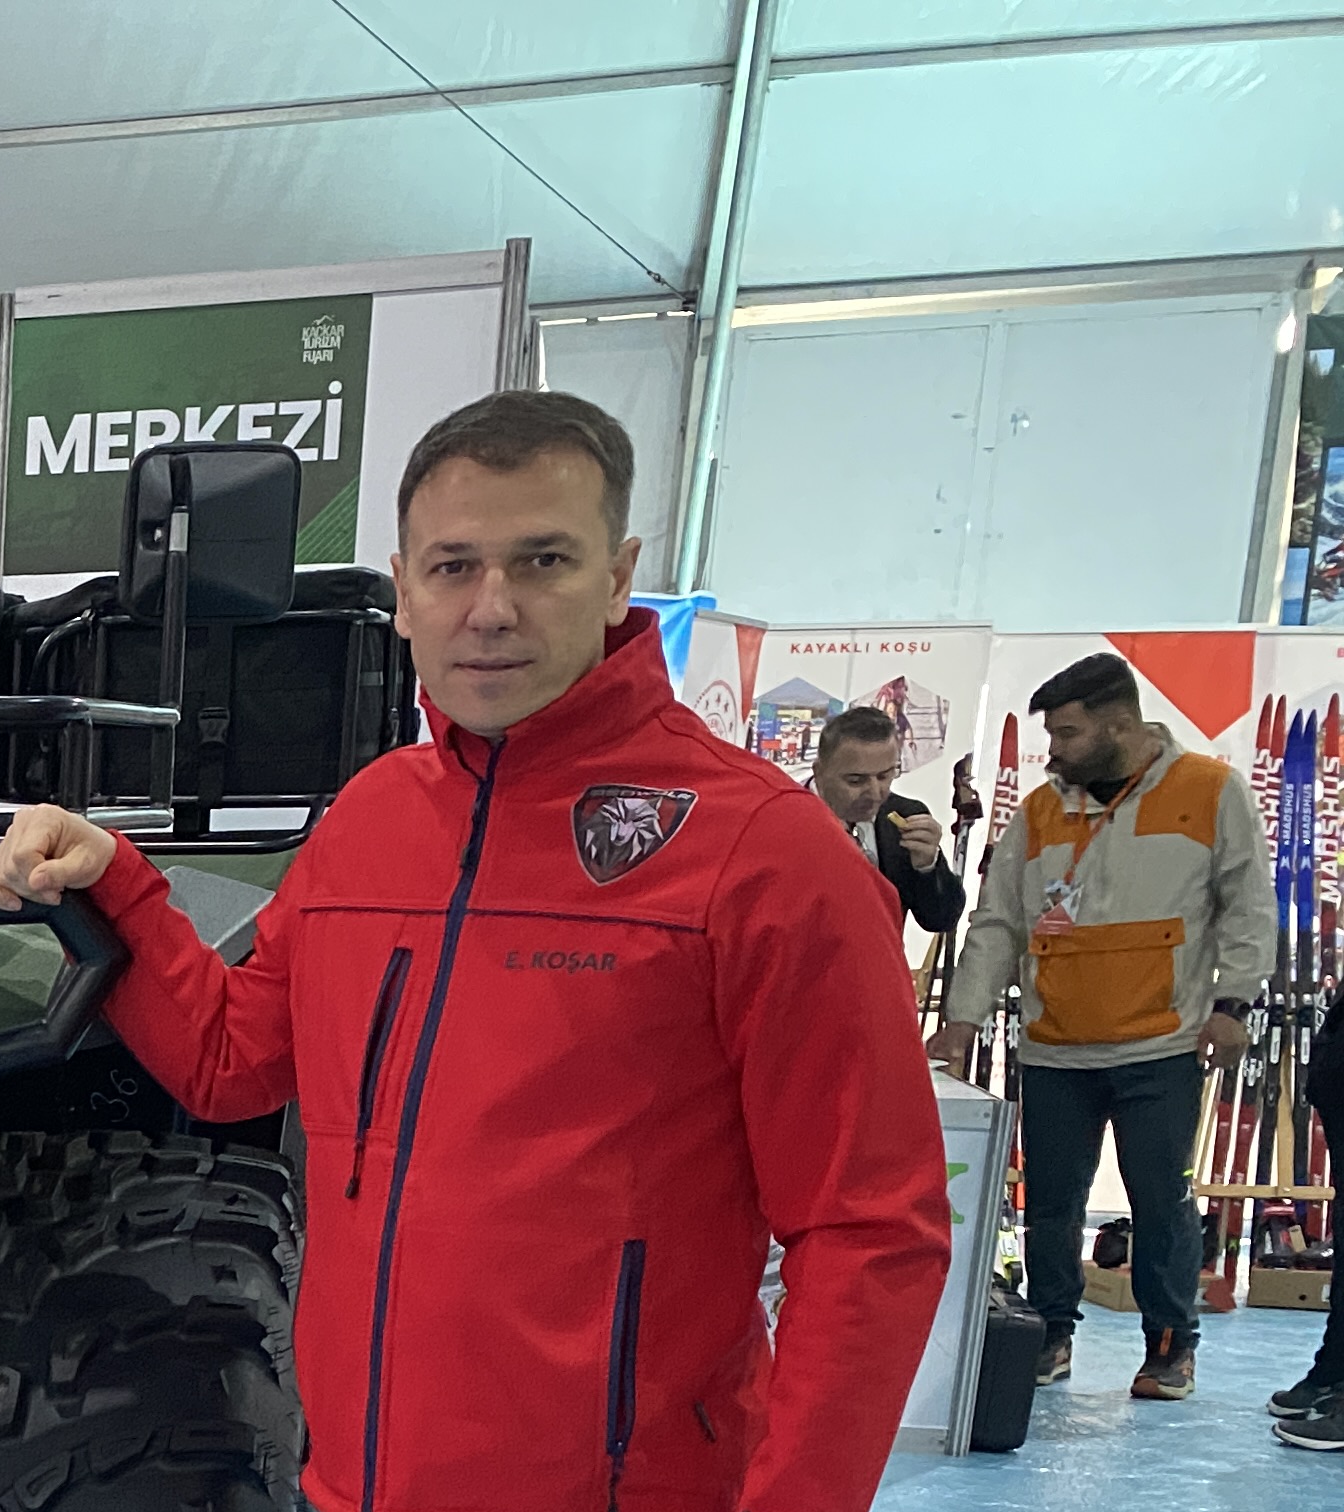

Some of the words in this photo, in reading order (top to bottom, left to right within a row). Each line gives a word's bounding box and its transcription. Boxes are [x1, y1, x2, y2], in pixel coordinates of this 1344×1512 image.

[790, 641, 870, 654] KAYAKLI
[879, 641, 932, 655] KOŞU
[531, 952, 616, 974] KOŞAR
